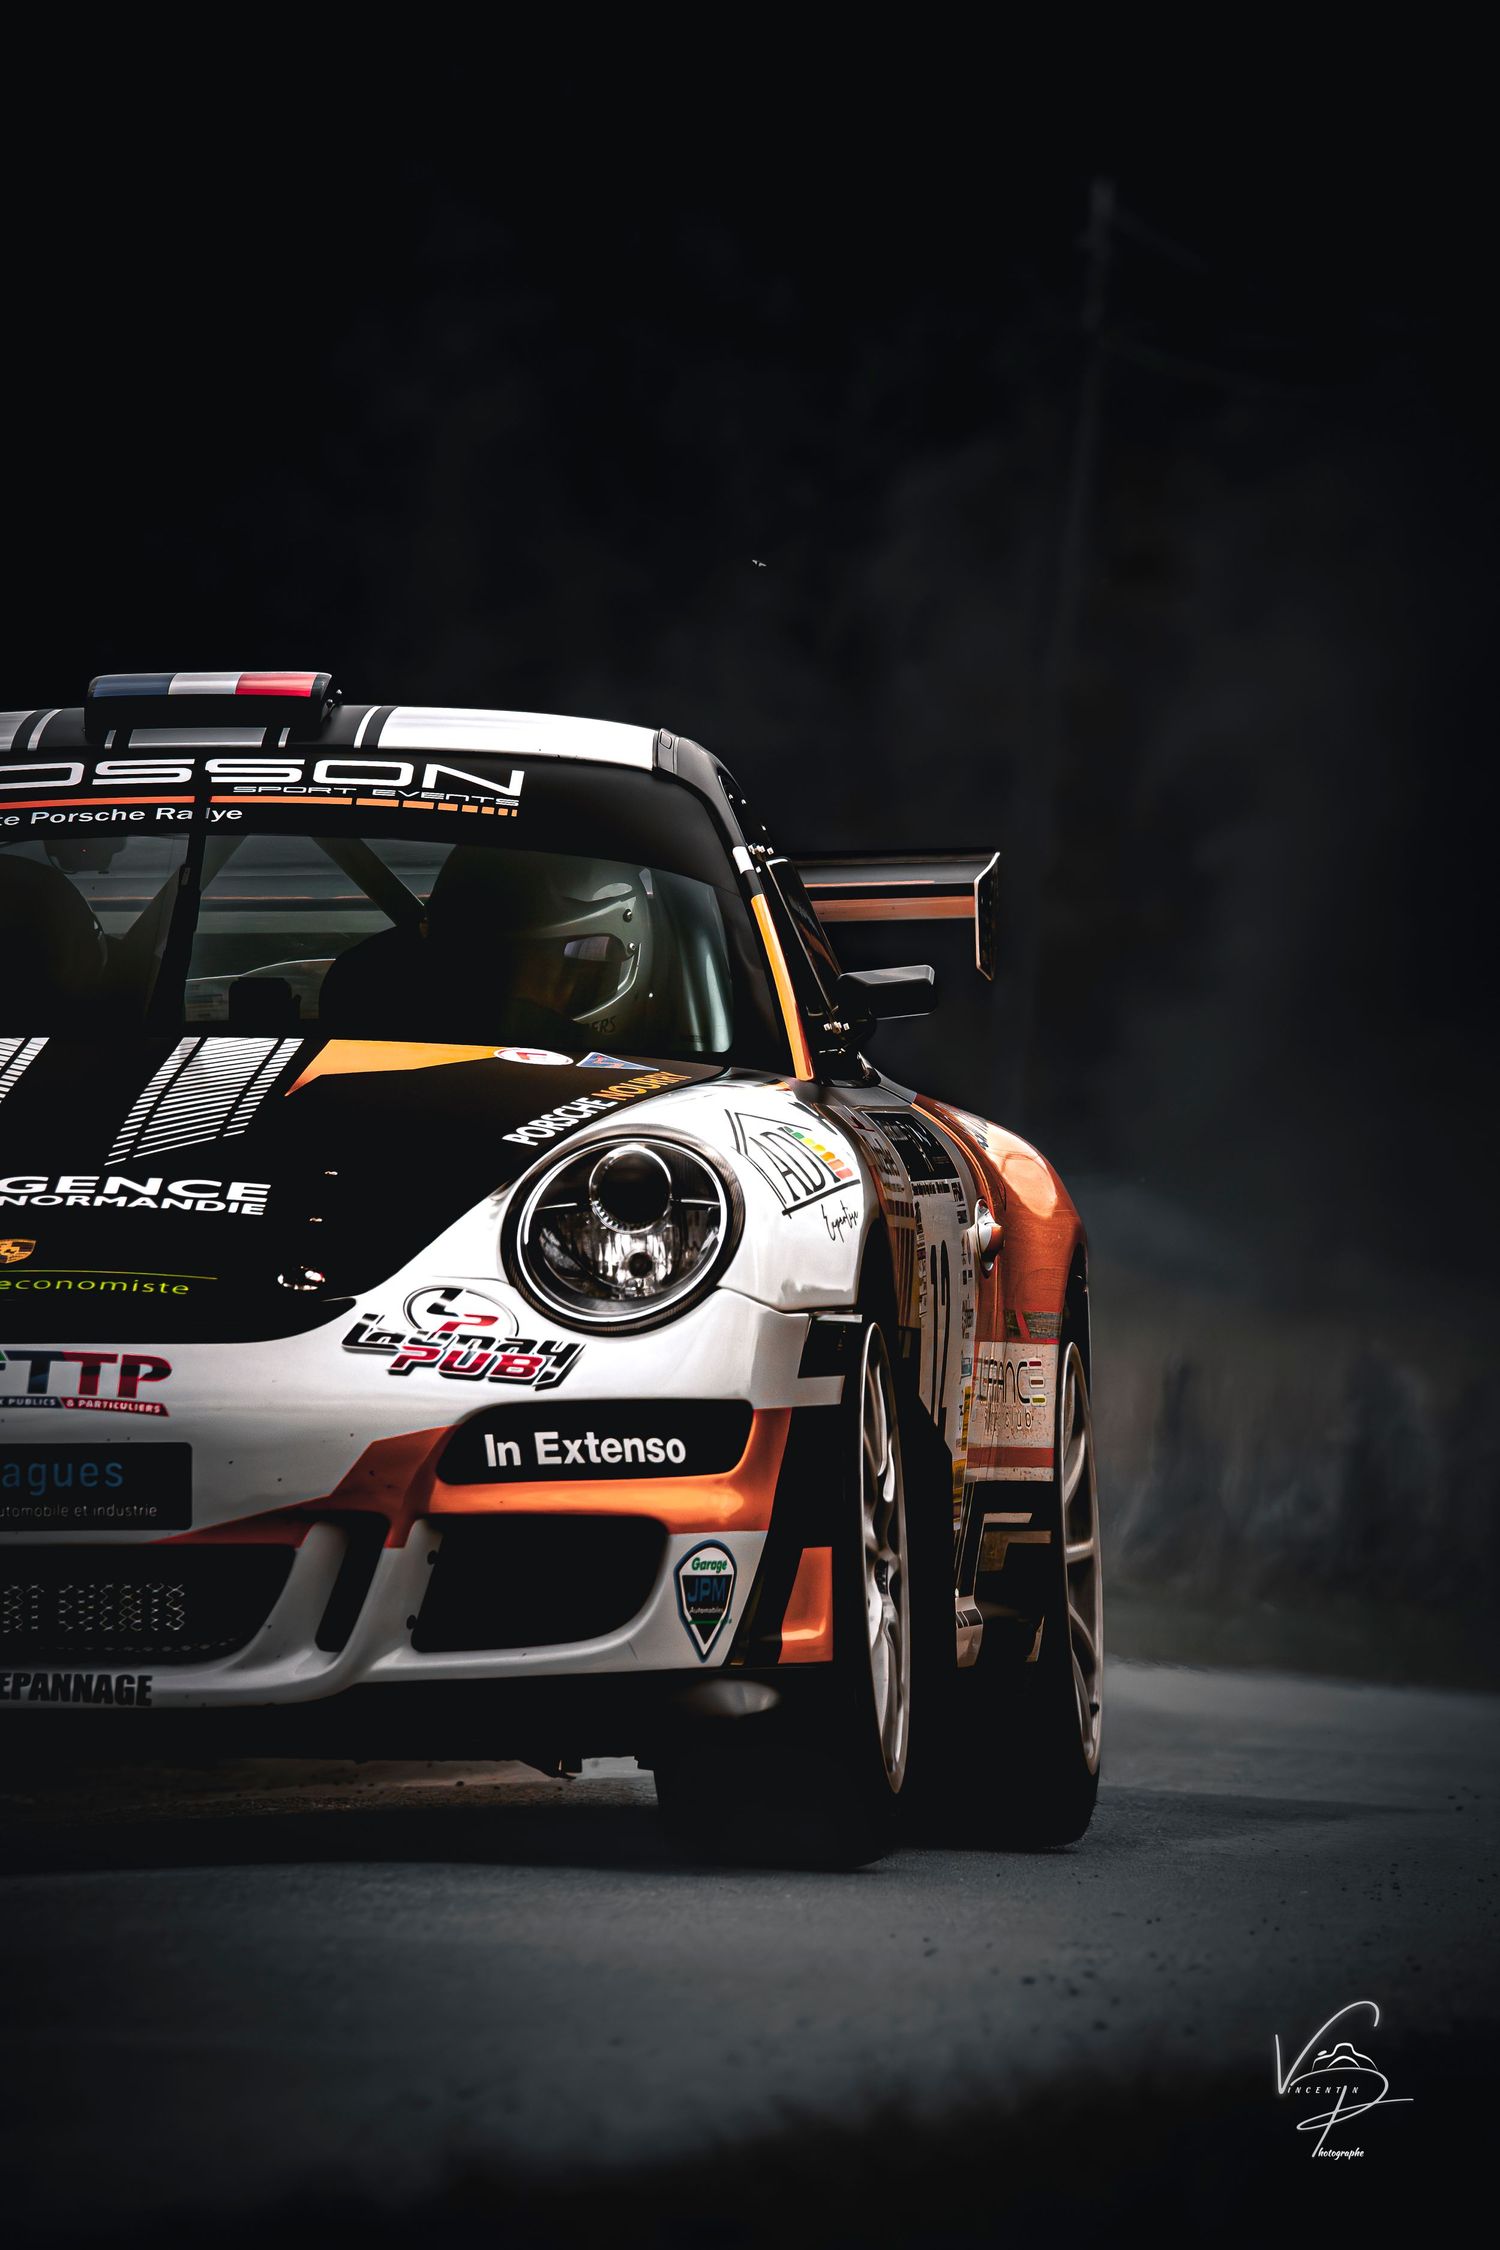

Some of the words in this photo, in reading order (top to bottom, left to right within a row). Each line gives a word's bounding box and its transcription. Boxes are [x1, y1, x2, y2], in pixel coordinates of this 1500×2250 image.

[233, 786, 357, 796] SPORT
[372, 789, 520, 807] EVENTS
[30, 808, 146, 825] Porsche
[155, 807, 243, 823] Ralye
[502, 1096, 618, 1146] PORSCHE
[0, 1175, 272, 1204] GENCE
[0, 1194, 266, 1216] NORMANDIE
[0, 1278, 190, 1296] economiste
[0, 1350, 172, 1399] TTP
[387, 1345, 546, 1385] PUB
[8, 1397, 57, 1407] PUBLICS
[78, 1399, 162, 1414] PARTICULIERS
[484, 1433, 522, 1468] In
[533, 1431, 687, 1466] Extenso
[1, 1462, 125, 1497] agues
[74, 1505, 88, 1518] et
[93, 1504, 158, 1518] industrie
[691, 1557, 728, 1574] Garage
[687, 1576, 727, 1603] JPM
